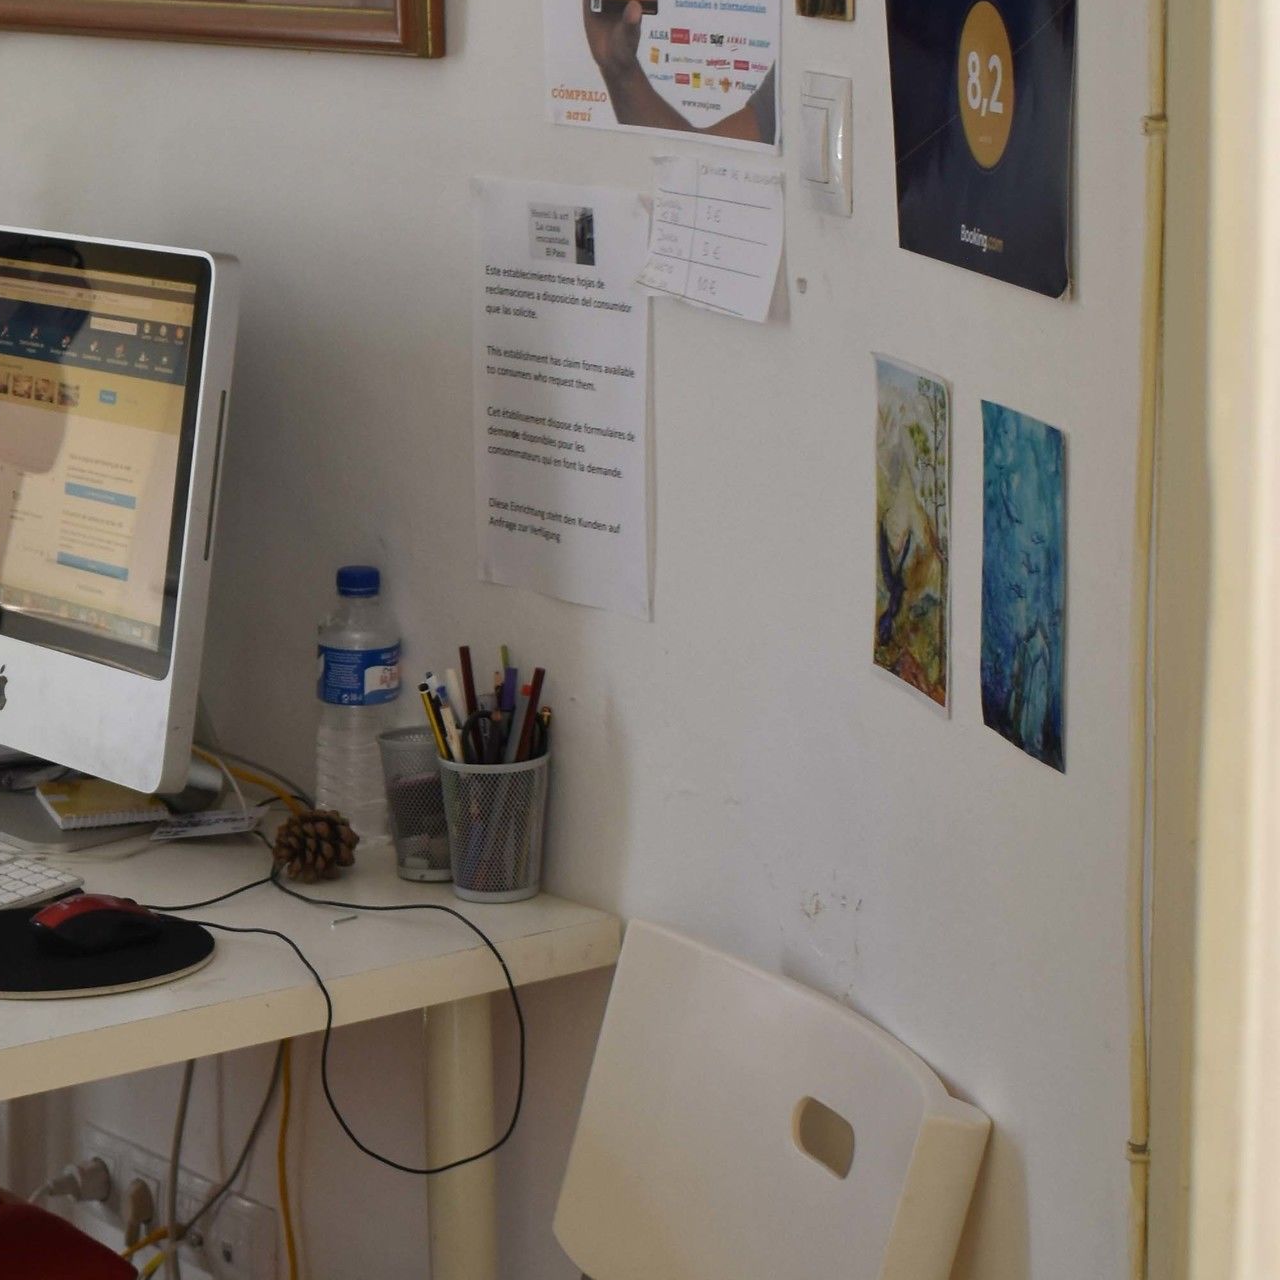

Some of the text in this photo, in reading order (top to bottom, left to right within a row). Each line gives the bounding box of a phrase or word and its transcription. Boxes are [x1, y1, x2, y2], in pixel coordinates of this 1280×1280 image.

[967, 51, 1004, 117] 8,2
[551, 85, 607, 102] CÓMPRALO
[960, 224, 1004, 253] Booking.com
[485, 265, 501, 275] Este
[597, 278, 605, 289] de
[581, 294, 592, 306] del
[485, 305, 500, 315] que
[487, 345, 502, 357] This
[573, 423, 582, 433] de
